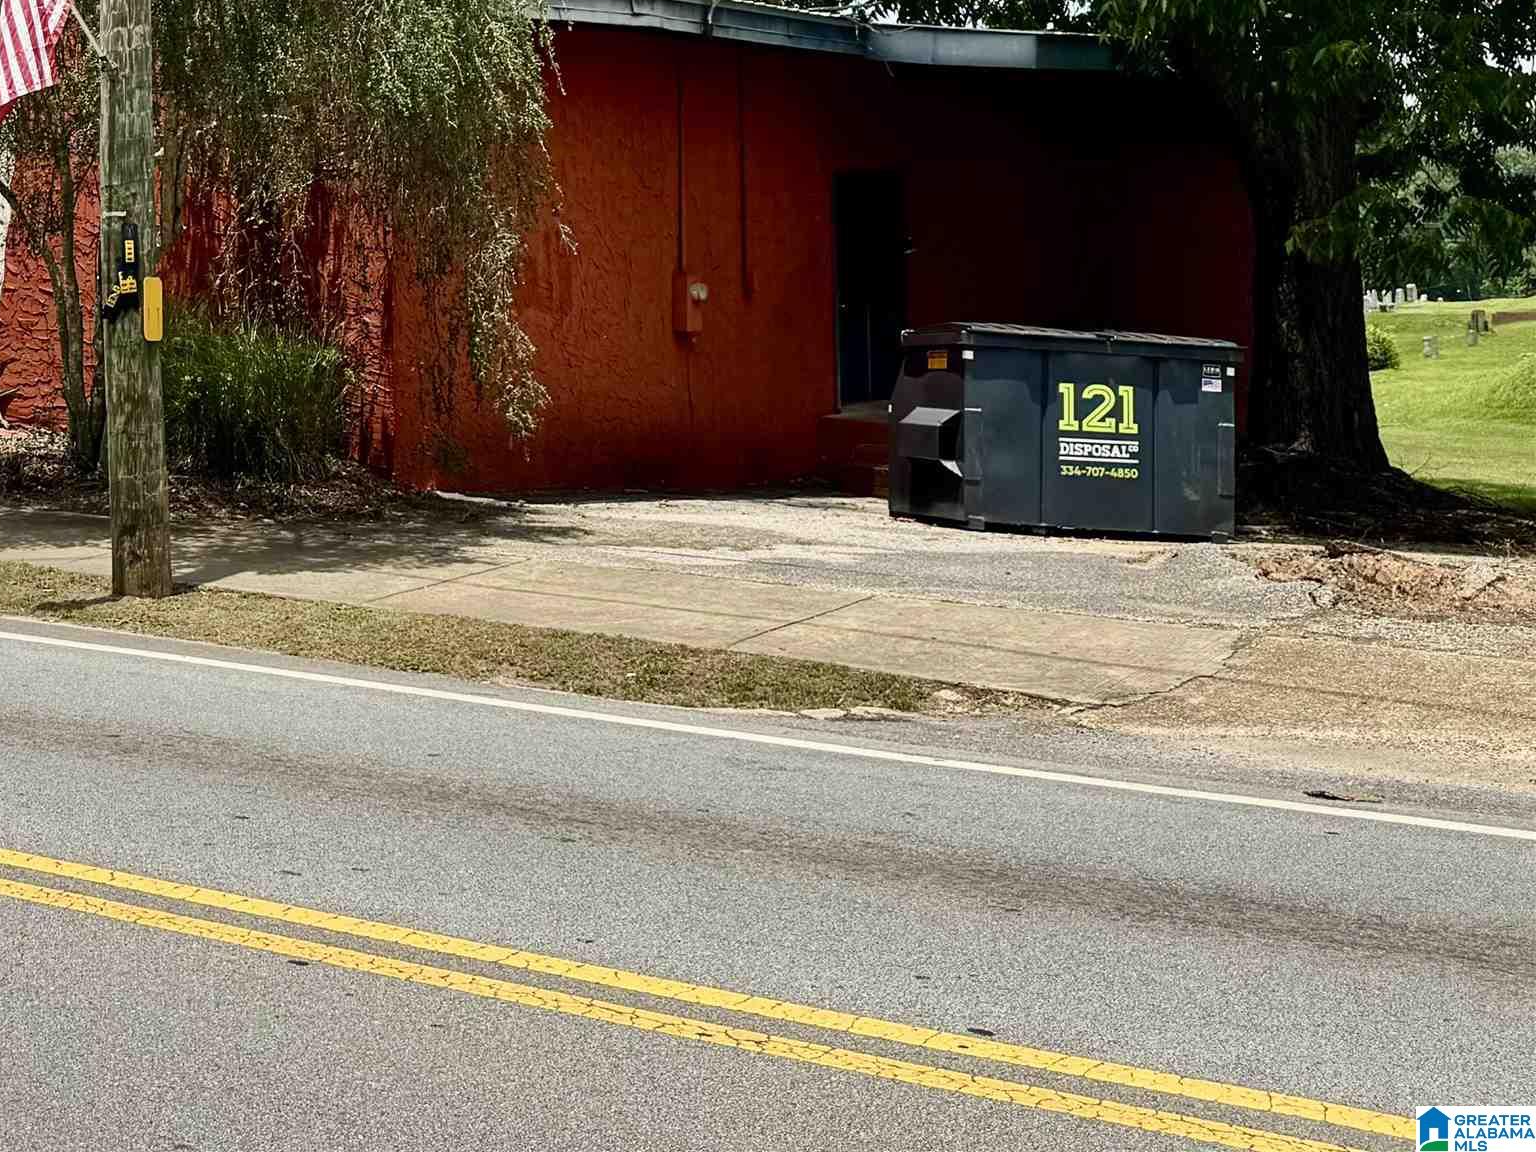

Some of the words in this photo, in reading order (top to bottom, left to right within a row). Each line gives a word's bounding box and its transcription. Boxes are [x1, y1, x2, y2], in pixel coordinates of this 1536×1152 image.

[1058, 382, 1139, 434] 121
[1059, 442, 1130, 458] DISPOSAL
[1060, 465, 1139, 479] 334-707-4850
